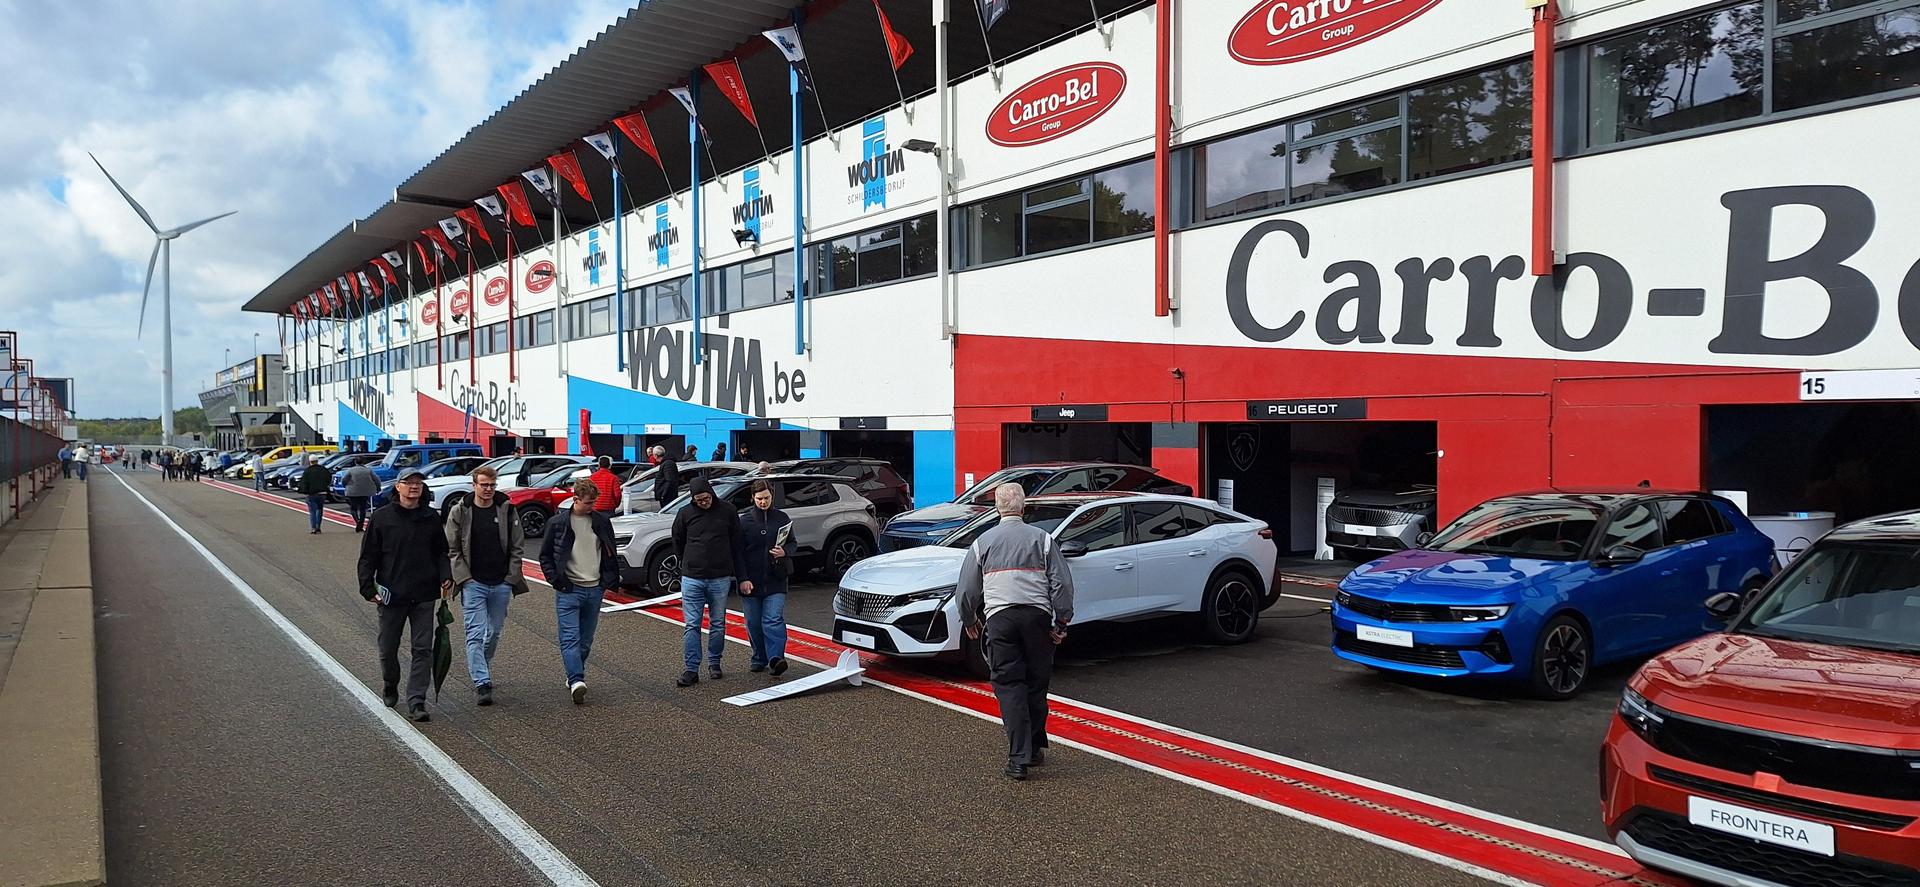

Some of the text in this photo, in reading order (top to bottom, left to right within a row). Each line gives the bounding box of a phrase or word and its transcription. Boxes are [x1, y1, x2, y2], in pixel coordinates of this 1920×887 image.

[1321, 24, 1355, 41] Group
[1008, 69, 1098, 125] Carro-Bel
[1041, 120, 1062, 132] Group
[847, 178, 905, 205] SCHILDERSBEDRIJF
[1225, 184, 1920, 356] Carro-B
[1803, 378, 1826, 395] 15
[451, 368, 527, 428] Carro-Bel.be
[1059, 408, 1076, 419] Jeep
[1248, 405, 1258, 417] 16
[1267, 403, 1339, 415] PEUGEOT
[1710, 808, 1810, 844] FRONTERA
